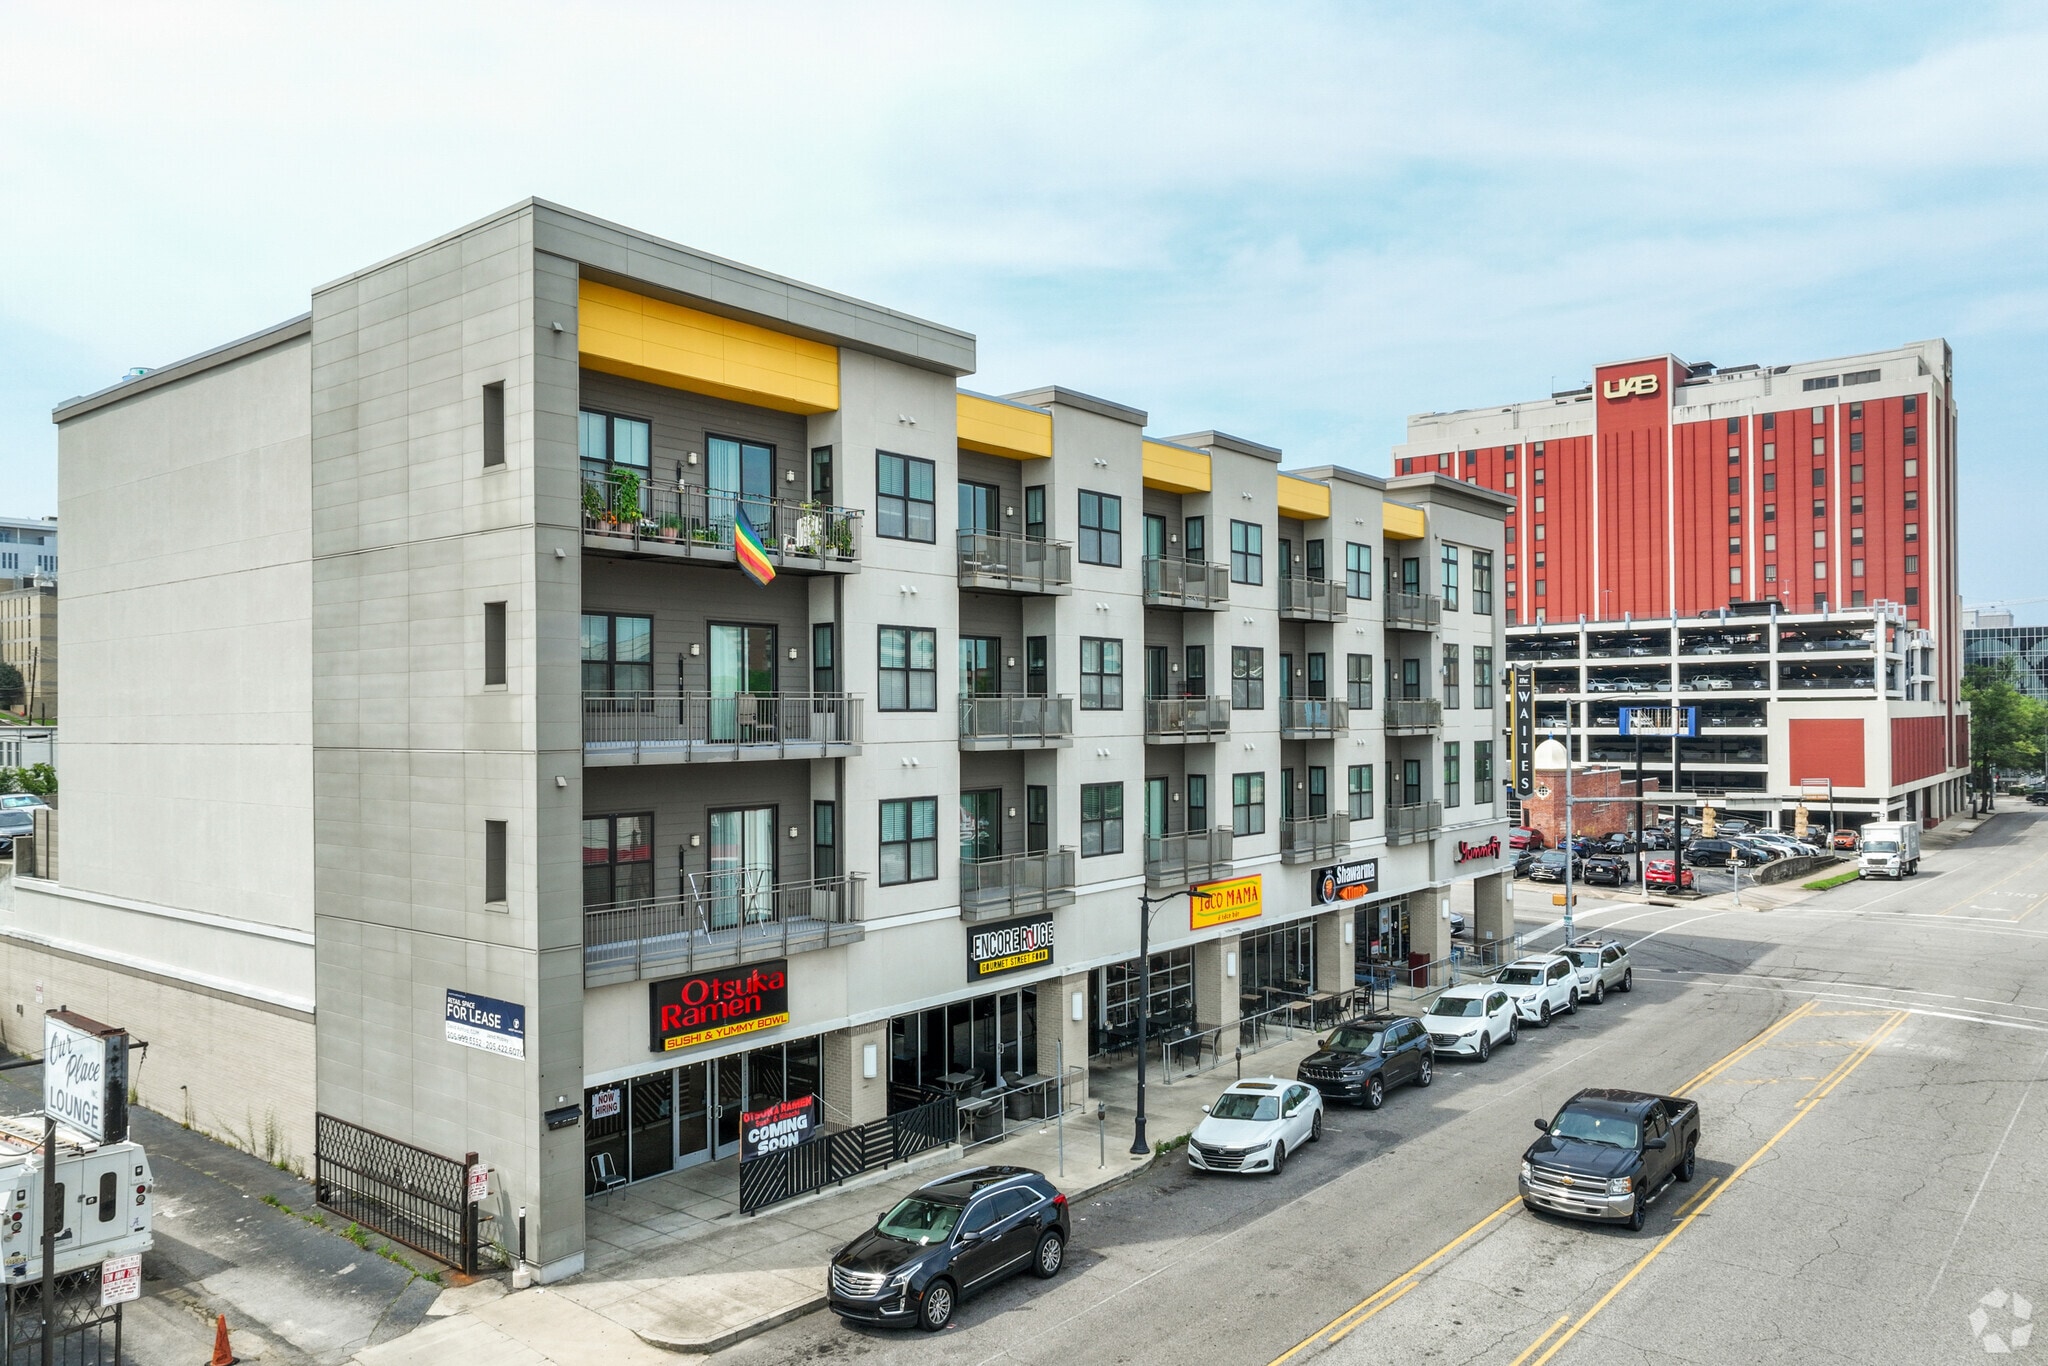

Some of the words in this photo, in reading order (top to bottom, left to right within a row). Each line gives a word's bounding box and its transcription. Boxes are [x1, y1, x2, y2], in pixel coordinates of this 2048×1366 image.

[1603, 374, 1659, 399] UAB
[1517, 691, 1531, 789] WAITES
[1336, 862, 1375, 885] Shawarma
[1226, 886, 1259, 908] MAMA
[973, 927, 1020, 961] ENCORE
[1020, 921, 1054, 951] ROUGE
[981, 958, 1008, 972] GOURMET
[1010, 954, 1030, 966] STREET
[1031, 950, 1046, 960] FOOD
[681, 968, 785, 1006] Otsuka
[447, 996, 462, 1006] RETAIL
[462, 1000, 476, 1009] SPACE
[661, 995, 762, 1032] Ramen
[446, 1003, 467, 1021] FOR
[469, 1008, 501, 1029] LEASE
[667, 1033, 702, 1049] SUSHI
[704, 1031, 713, 1040] &
[716, 1022, 755, 1037] YUMMY
[757, 1015, 787, 1028] BOWL
[50, 1031, 72, 1066] Our
[66, 1054, 100, 1088] Place
[50, 1085, 99, 1129] LOUNGE
[595, 1102, 618, 1116] HIRING
[598, 1092, 615, 1105] NOW
[780, 1095, 813, 1113] RAMEN
[748, 1114, 808, 1144] COMING
[757, 1131, 800, 1156] SOON
